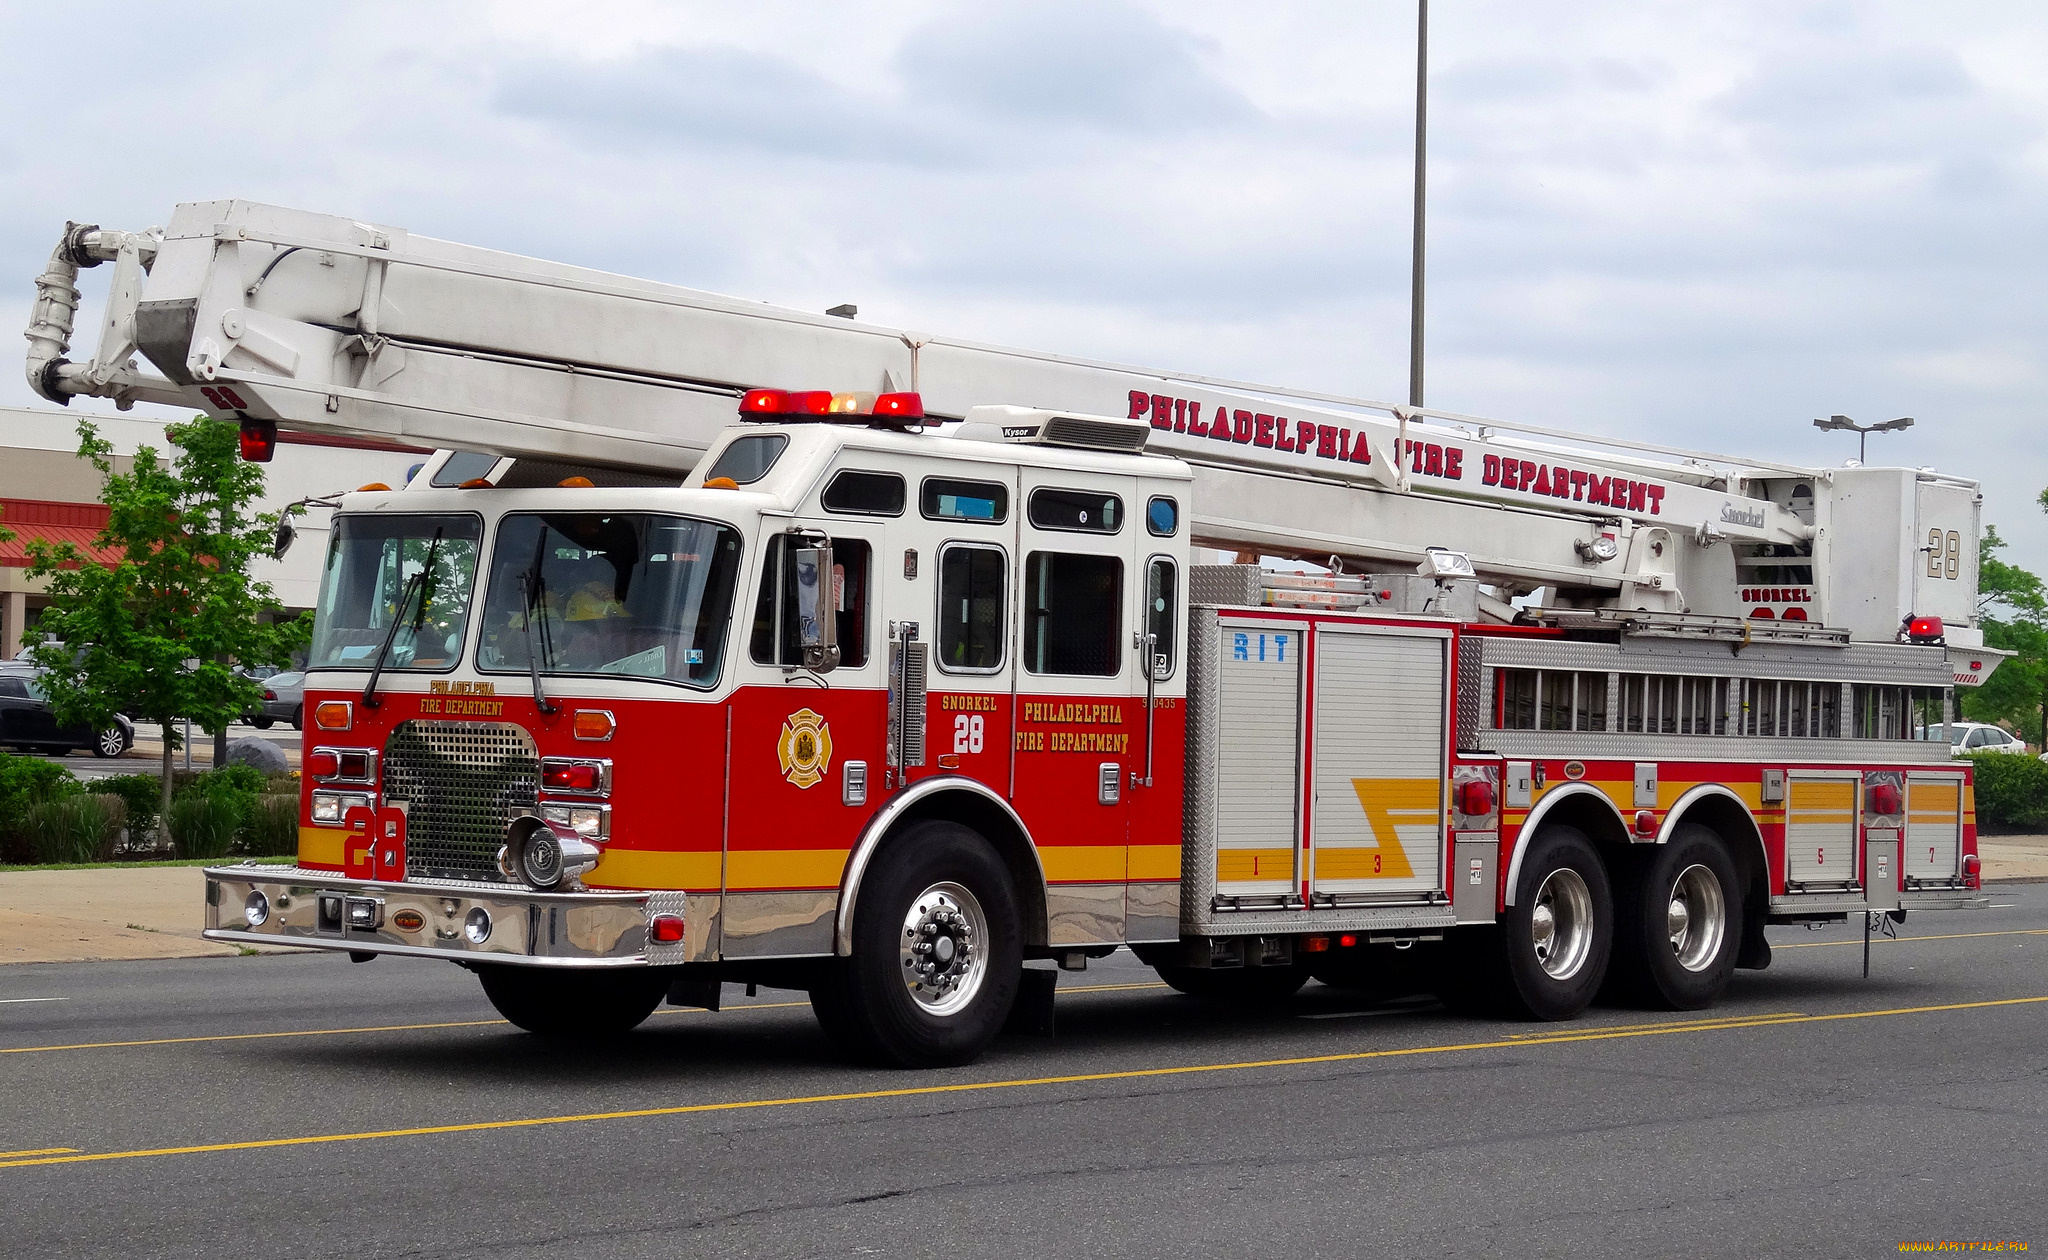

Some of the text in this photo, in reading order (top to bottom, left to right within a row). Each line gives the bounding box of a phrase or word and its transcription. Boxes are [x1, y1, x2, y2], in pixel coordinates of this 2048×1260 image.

[1004, 428, 1029, 437] Kysor
[1128, 390, 1372, 465] PHILADELPHIA
[1482, 453, 1666, 515] DEPARTMENT
[1927, 528, 1960, 580] 28
[1742, 589, 1812, 602] SNORKEL
[1234, 633, 1288, 662] RIT
[430, 680, 495, 696] PHILADELPHIA
[420, 698, 504, 716] FIRE DEPARTMENT
[942, 695, 997, 711] SNORKEL
[1024, 702, 1122, 724] PHILADELPHIA
[1142, 698, 1176, 709] 90435
[954, 714, 984, 754] 28
[1016, 731, 1129, 755] FIRE DEPARTMENT
[344, 806, 407, 882] 28
[1374, 854, 1382, 874] 3
[1817, 848, 1824, 865] 5
[1928, 847, 1935, 863] 7
[1253, 856, 1259, 876] 1
